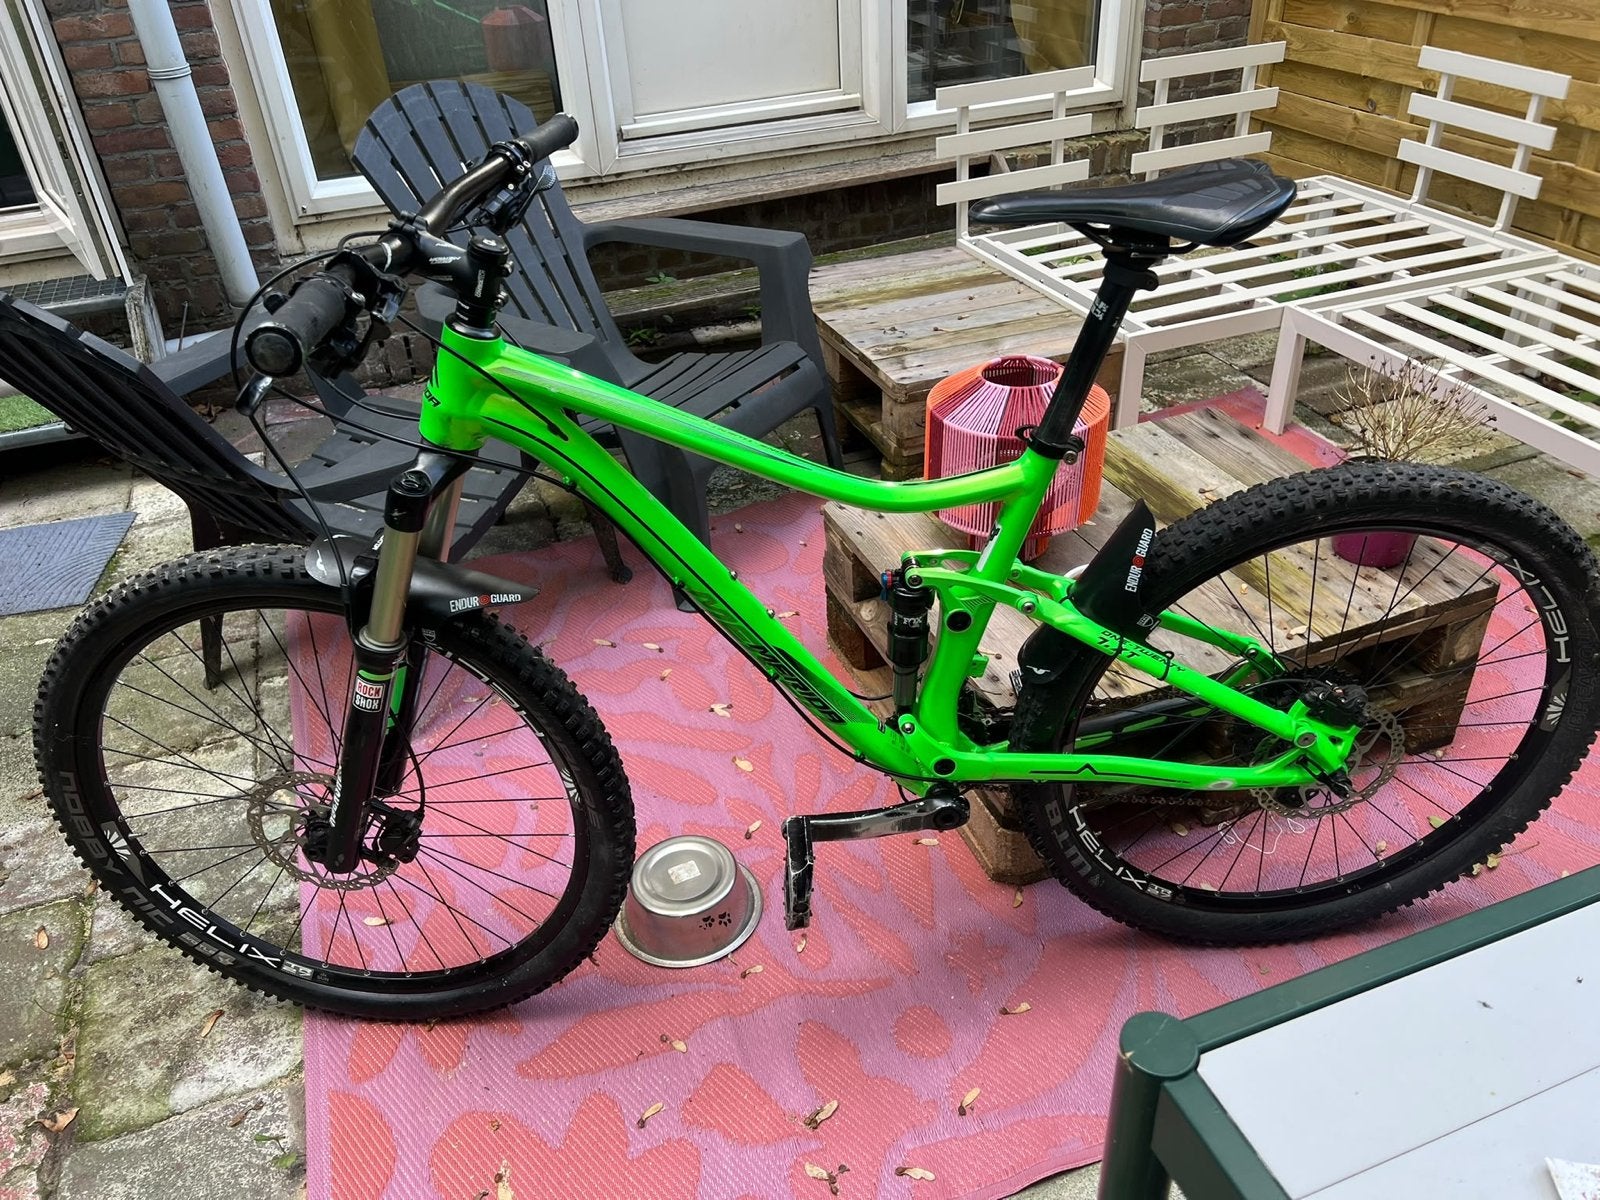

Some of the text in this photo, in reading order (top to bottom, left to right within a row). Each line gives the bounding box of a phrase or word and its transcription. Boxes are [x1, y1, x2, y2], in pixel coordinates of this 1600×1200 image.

[903, 616, 922, 627] FOX
[355, 694, 380, 710] SHOX
[357, 682, 381, 697] ROCK
[750, 645, 847, 724] MERIDA
[58, 770, 175, 928] NOBBY NIC
[1069, 805, 1148, 891] HELIX
[150, 883, 282, 969] HELIX
